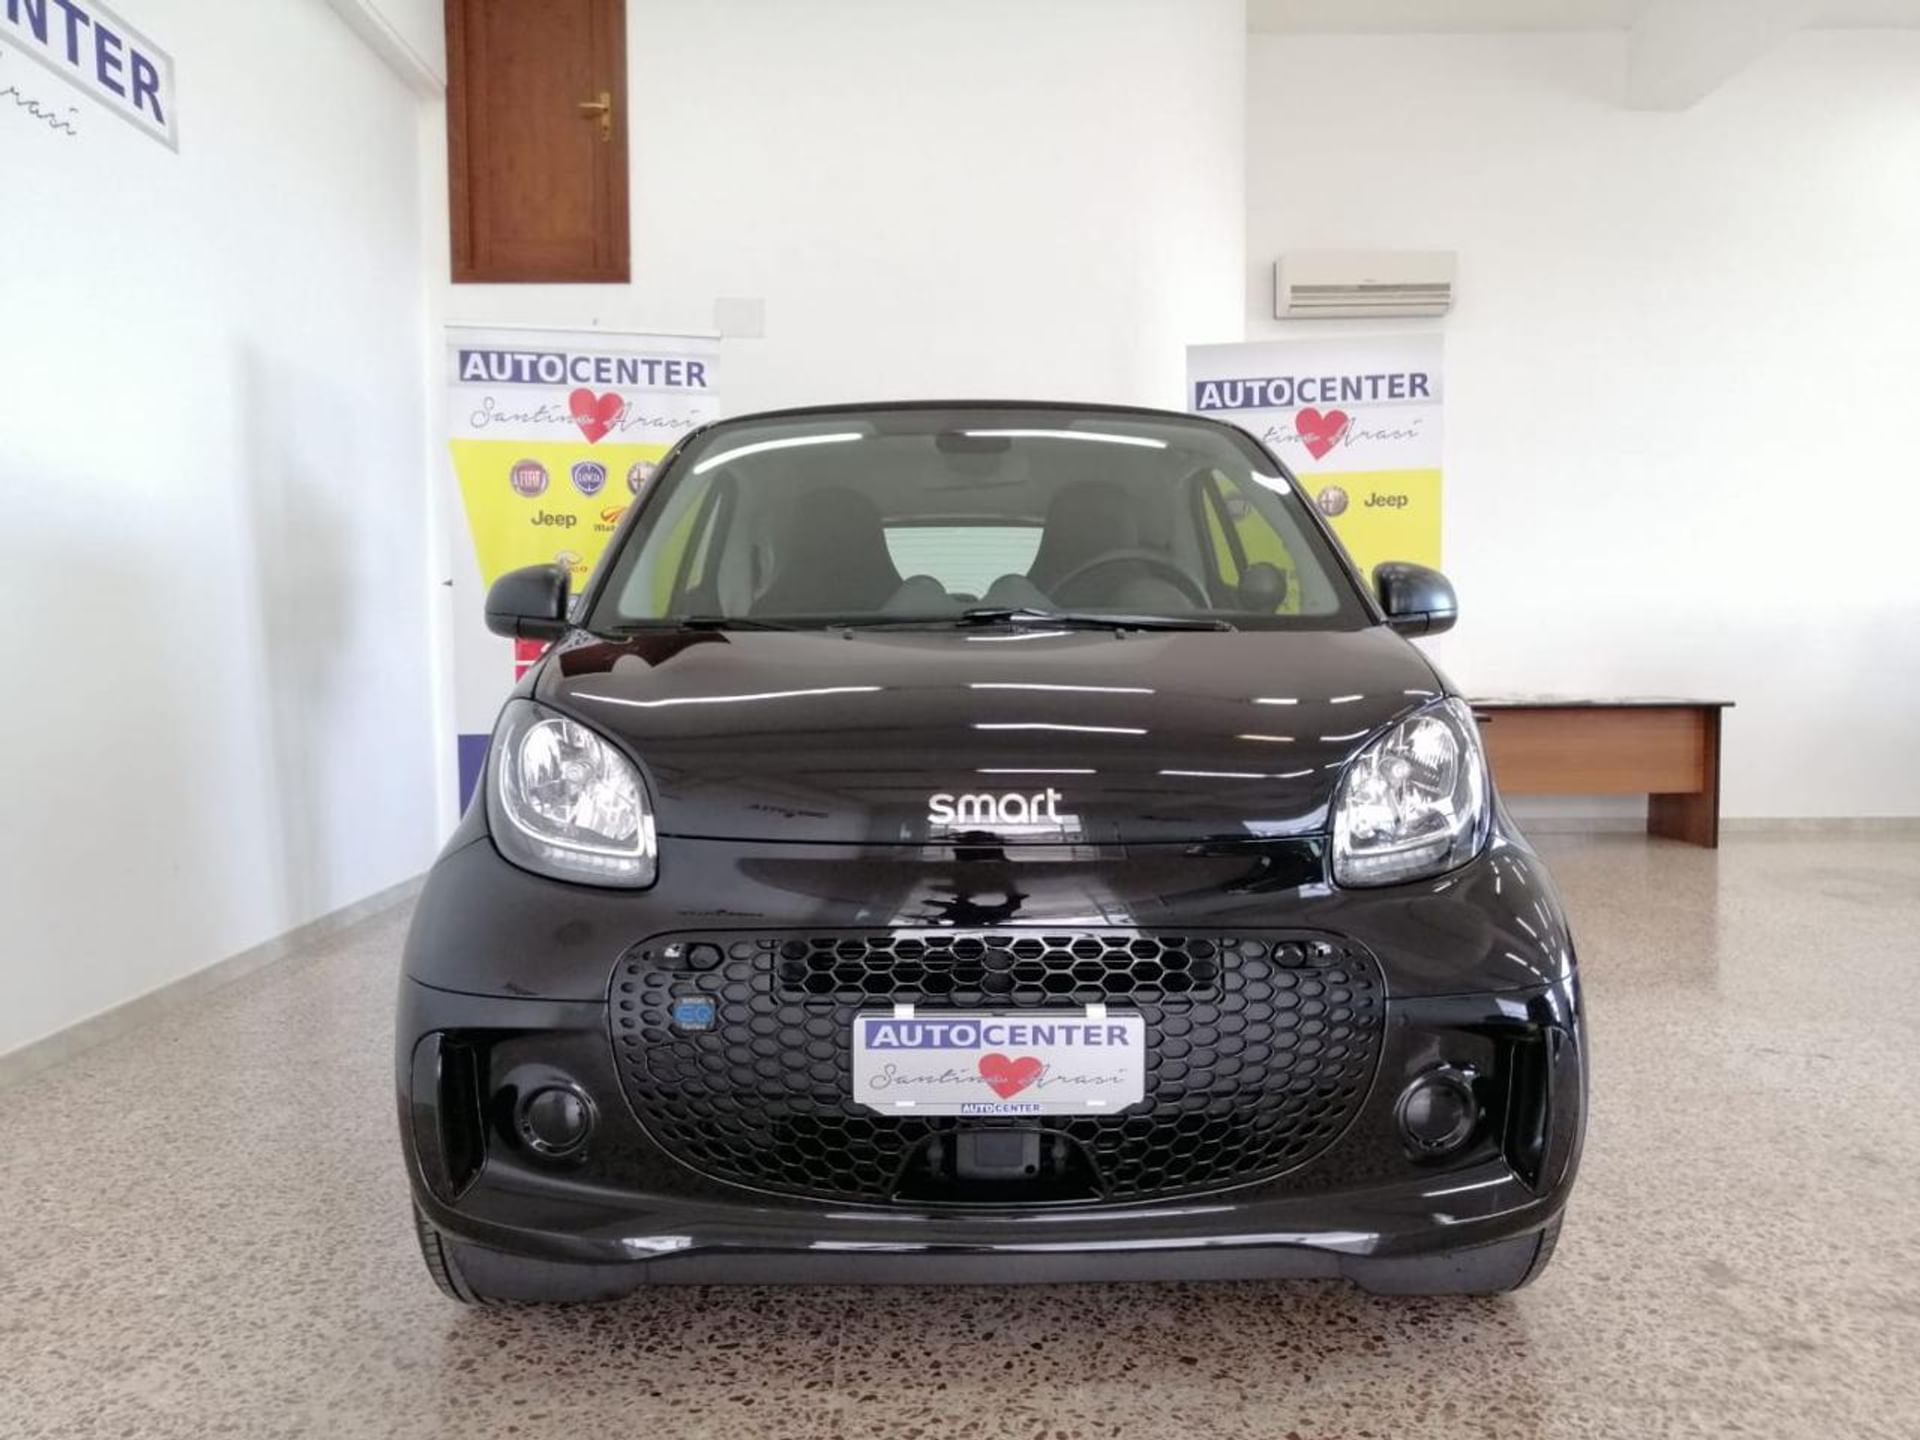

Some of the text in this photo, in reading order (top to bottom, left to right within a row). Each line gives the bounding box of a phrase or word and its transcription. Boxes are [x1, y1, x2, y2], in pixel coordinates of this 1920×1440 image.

[7, 0, 166, 126] NTER
[462, 352, 707, 387] AUTOCENTER
[1199, 373, 1430, 408] AUTOCENTER
[1364, 493, 1409, 509] Jeep
[531, 510, 577, 528] Jeep
[928, 787, 1063, 825] smart
[872, 1024, 1129, 1046] AUTOCENTER
[962, 1103, 1041, 1113] AUTOCENTER
